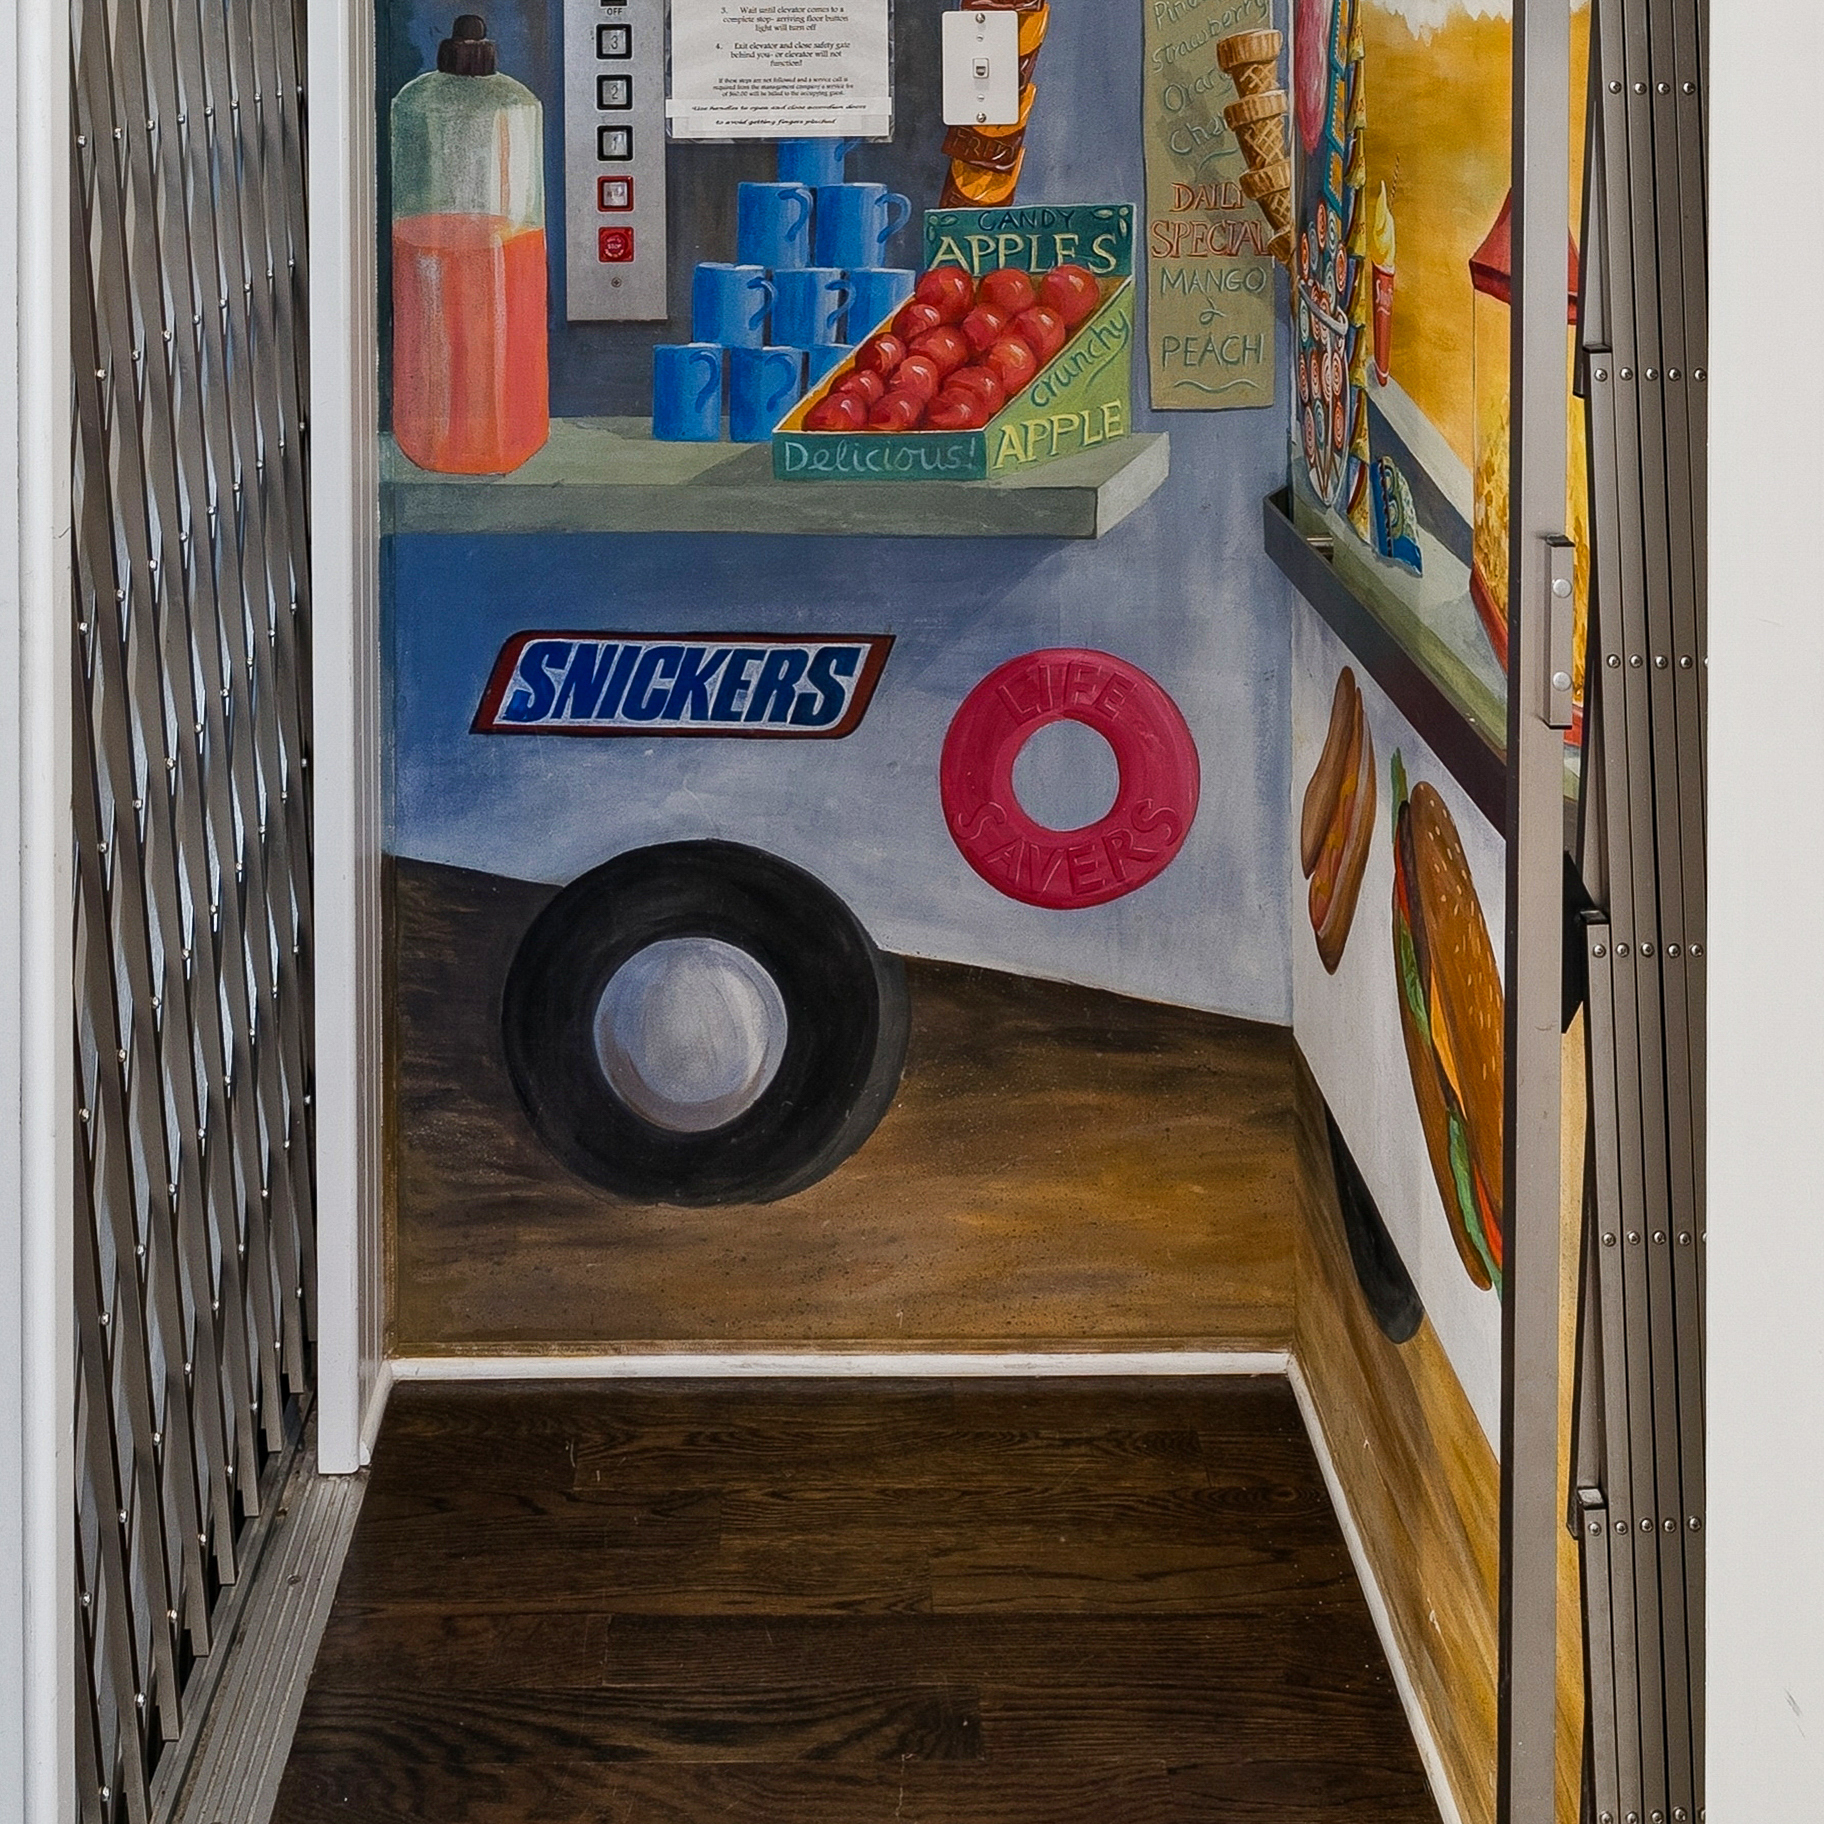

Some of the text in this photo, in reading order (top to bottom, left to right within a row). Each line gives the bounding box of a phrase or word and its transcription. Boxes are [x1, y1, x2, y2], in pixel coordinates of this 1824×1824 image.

[723, 16, 754, 24] complete
[755, 25, 772, 33] light
[610, 35, 618, 49] 3
[611, 84, 619, 99] 2
[1164, 65, 1234, 116] Orang
[977, 209, 1075, 231] CANDY
[932, 233, 1118, 275] APPLES
[1151, 220, 1274, 258] SPECIAL
[1160, 267, 1267, 297] MANGO
[1162, 333, 1264, 370] PEACH
[993, 400, 1125, 472] APPLE
[784, 438, 975, 472] Delicious!
[502, 640, 859, 726] SNICKERS
[995, 661, 1138, 727] LIFE
[954, 798, 1182, 896] SAVERS
